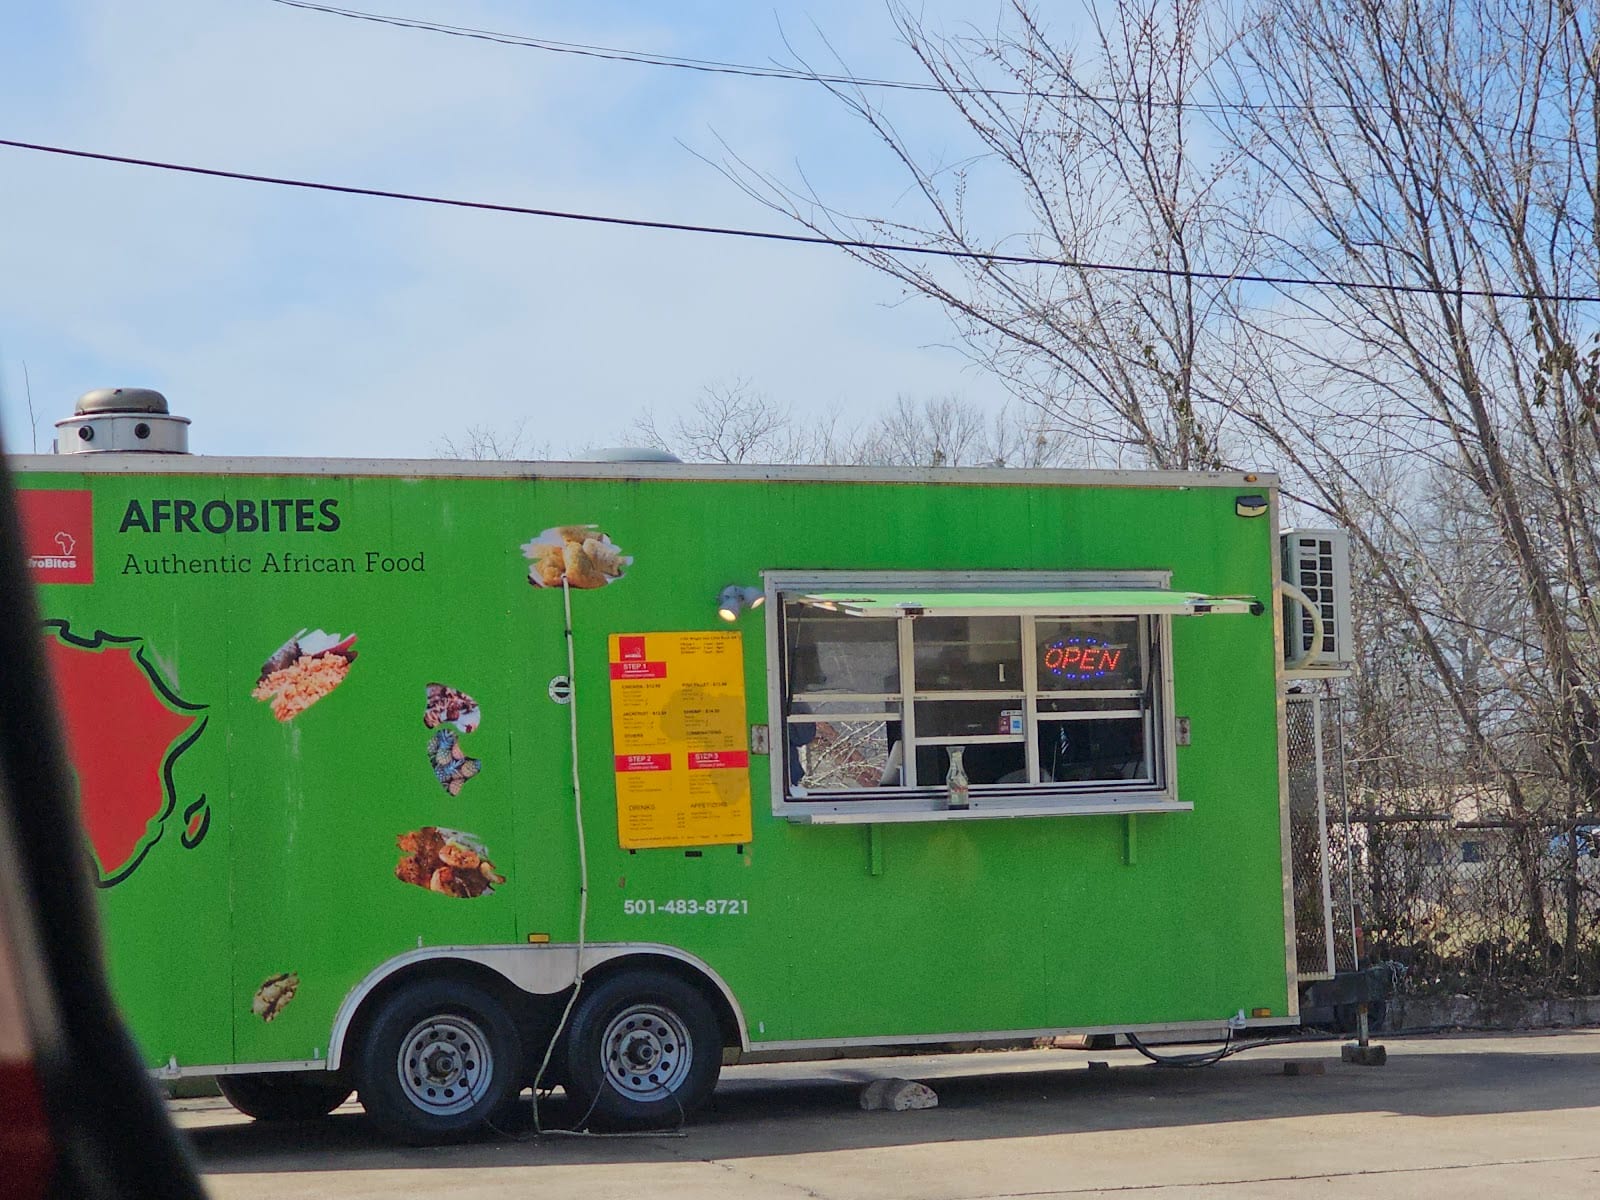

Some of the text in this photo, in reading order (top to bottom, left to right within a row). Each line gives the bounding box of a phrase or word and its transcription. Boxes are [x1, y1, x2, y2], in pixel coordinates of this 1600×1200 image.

[119, 498, 340, 534] AFROBITES
[121, 551, 426, 575] Authentic African Food
[1045, 646, 1121, 671] OPEN
[628, 755, 646, 763] STEP
[623, 899, 749, 915] 501-483-8721
